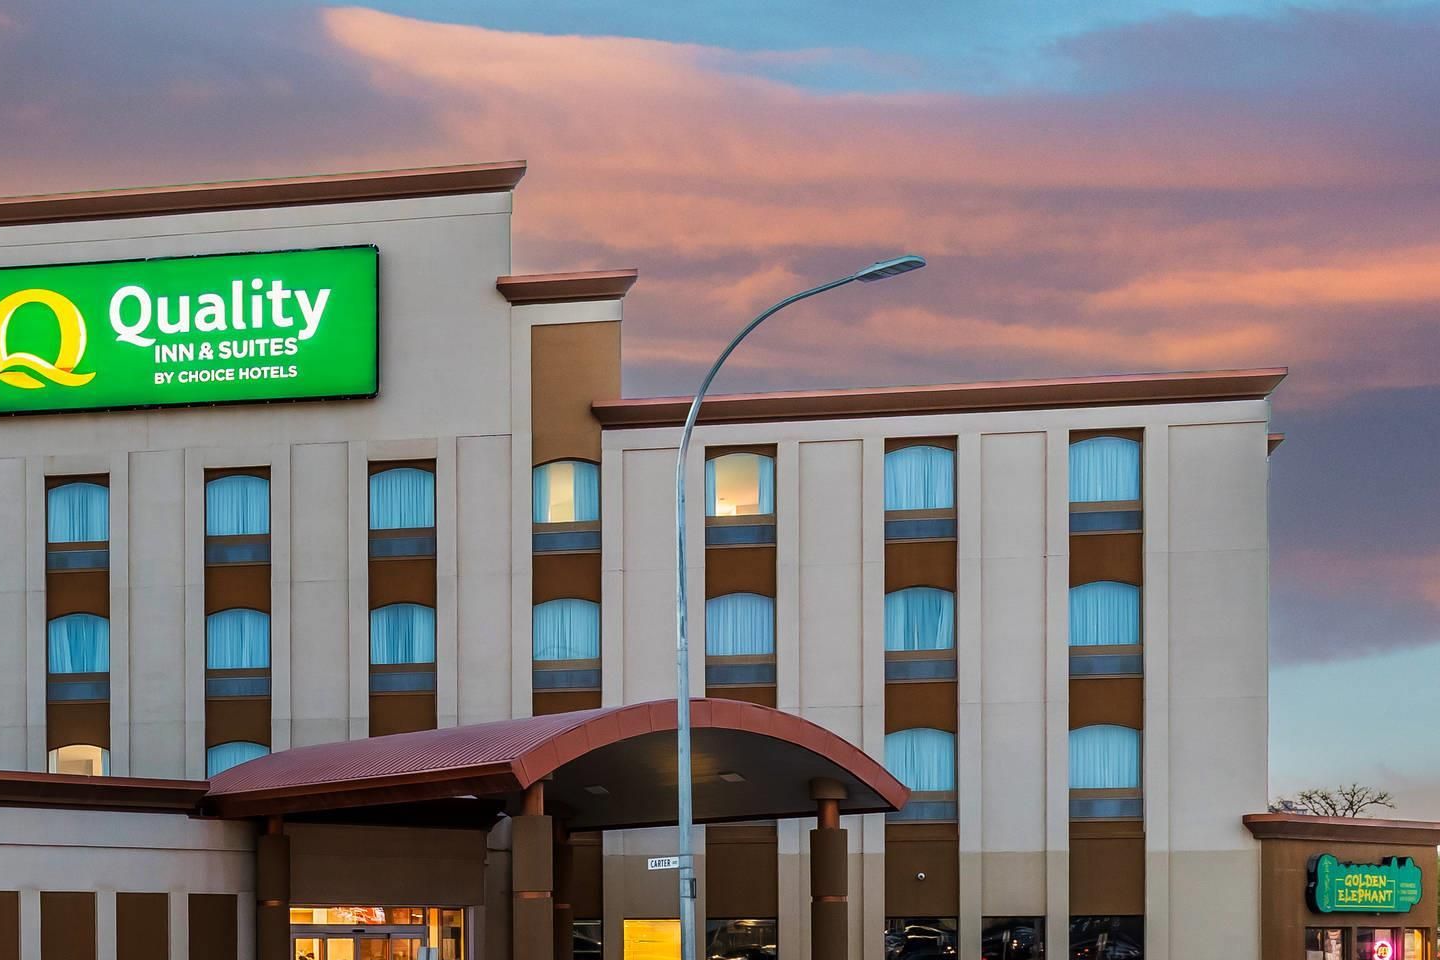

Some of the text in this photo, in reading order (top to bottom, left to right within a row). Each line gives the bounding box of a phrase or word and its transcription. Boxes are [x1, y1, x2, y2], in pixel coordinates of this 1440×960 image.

[109, 278, 331, 347] Quality
[154, 337, 298, 364] INN & SUITES
[154, 365, 298, 385] BY CHOICE HOTELS
[650, 859, 671, 868] CARTER
[1344, 874, 1387, 888] GOLDEN
[1337, 888, 1393, 904] ELEPHANT
